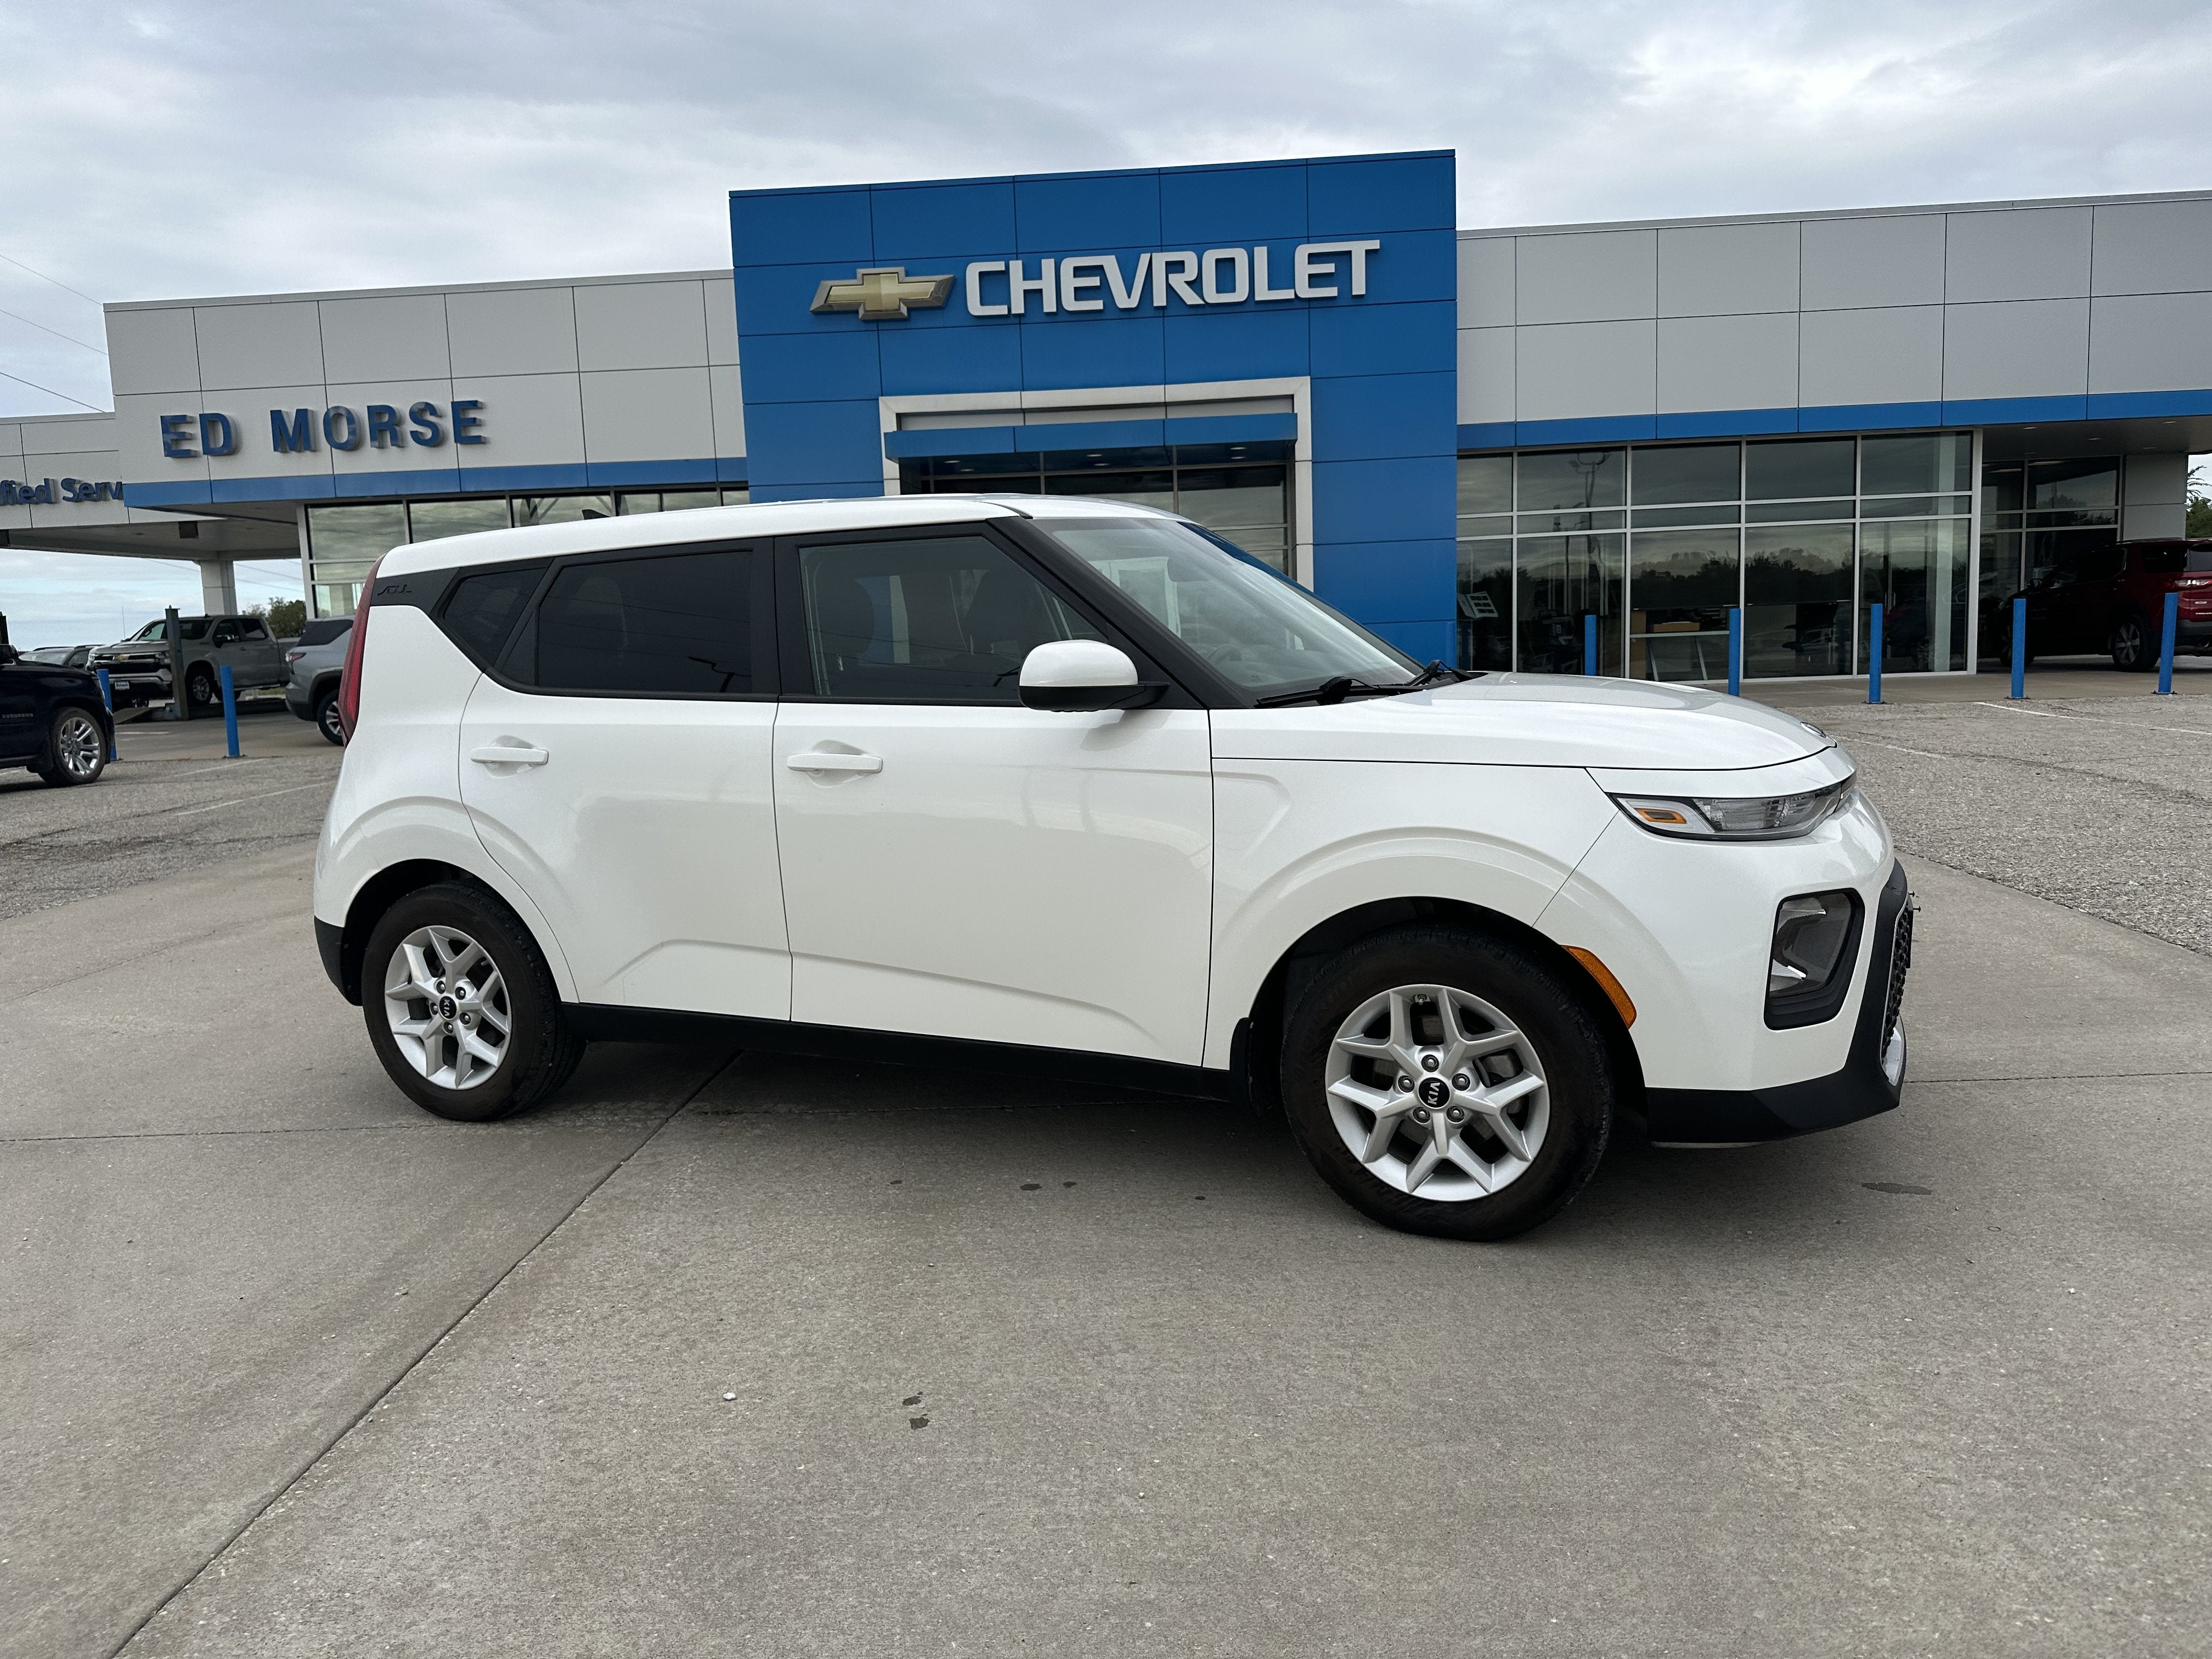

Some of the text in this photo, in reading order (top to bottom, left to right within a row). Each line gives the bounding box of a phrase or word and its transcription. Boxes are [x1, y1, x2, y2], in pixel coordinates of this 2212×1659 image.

[966, 240, 1380, 317] CHEVROLET
[160, 400, 487, 458] ED MORSE
[1427, 1082, 1441, 1105] KIA
